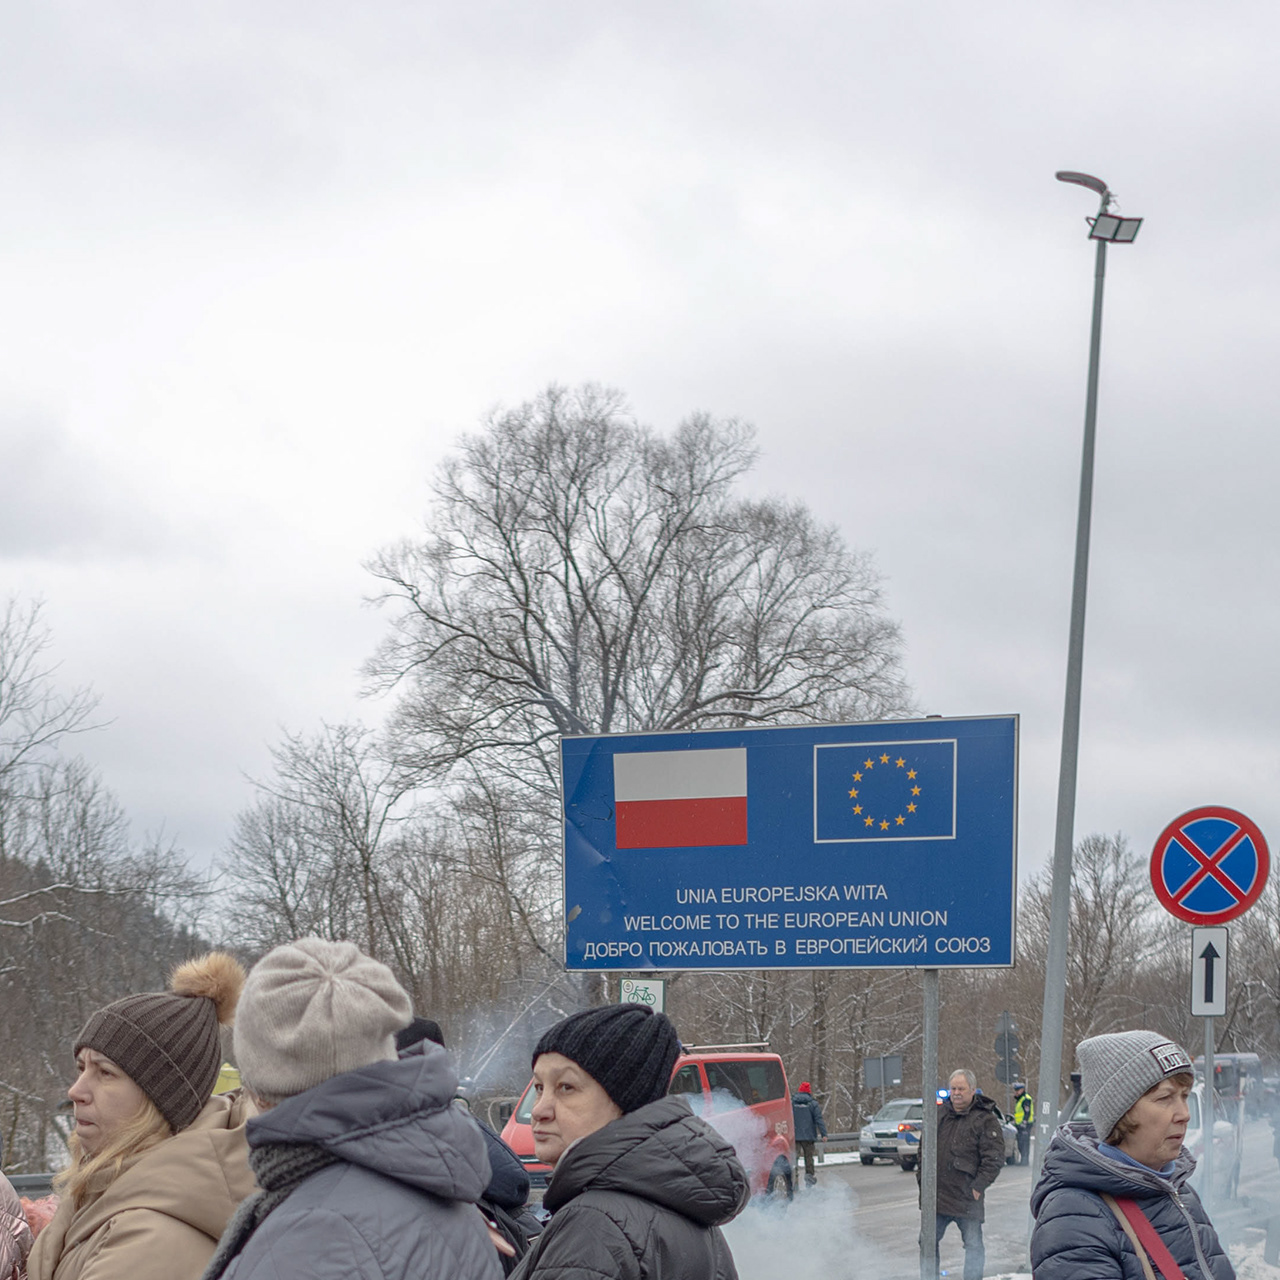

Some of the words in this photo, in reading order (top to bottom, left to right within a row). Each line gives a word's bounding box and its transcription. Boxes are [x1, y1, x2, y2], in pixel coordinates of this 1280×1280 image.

[676, 888, 717, 904] UNIA
[721, 885, 840, 903] EUROPEJSKA
[843, 884, 888, 901] WITA
[623, 915, 711, 931] WELCOME
[716, 914, 740, 930] TO
[744, 913, 779, 929] THE
[784, 912, 884, 928] EUROPEAN
[888, 910, 948, 927] UNION
[583, 942, 642, 960] ДОБРО
[649, 940, 768, 957] ПОЖАЛОВАТЬ
[775, 940, 787, 955] В
[795, 935, 927, 955] ЕВРОПЕЙСКИЙ
[935, 937, 991, 953] СОЮЗ
